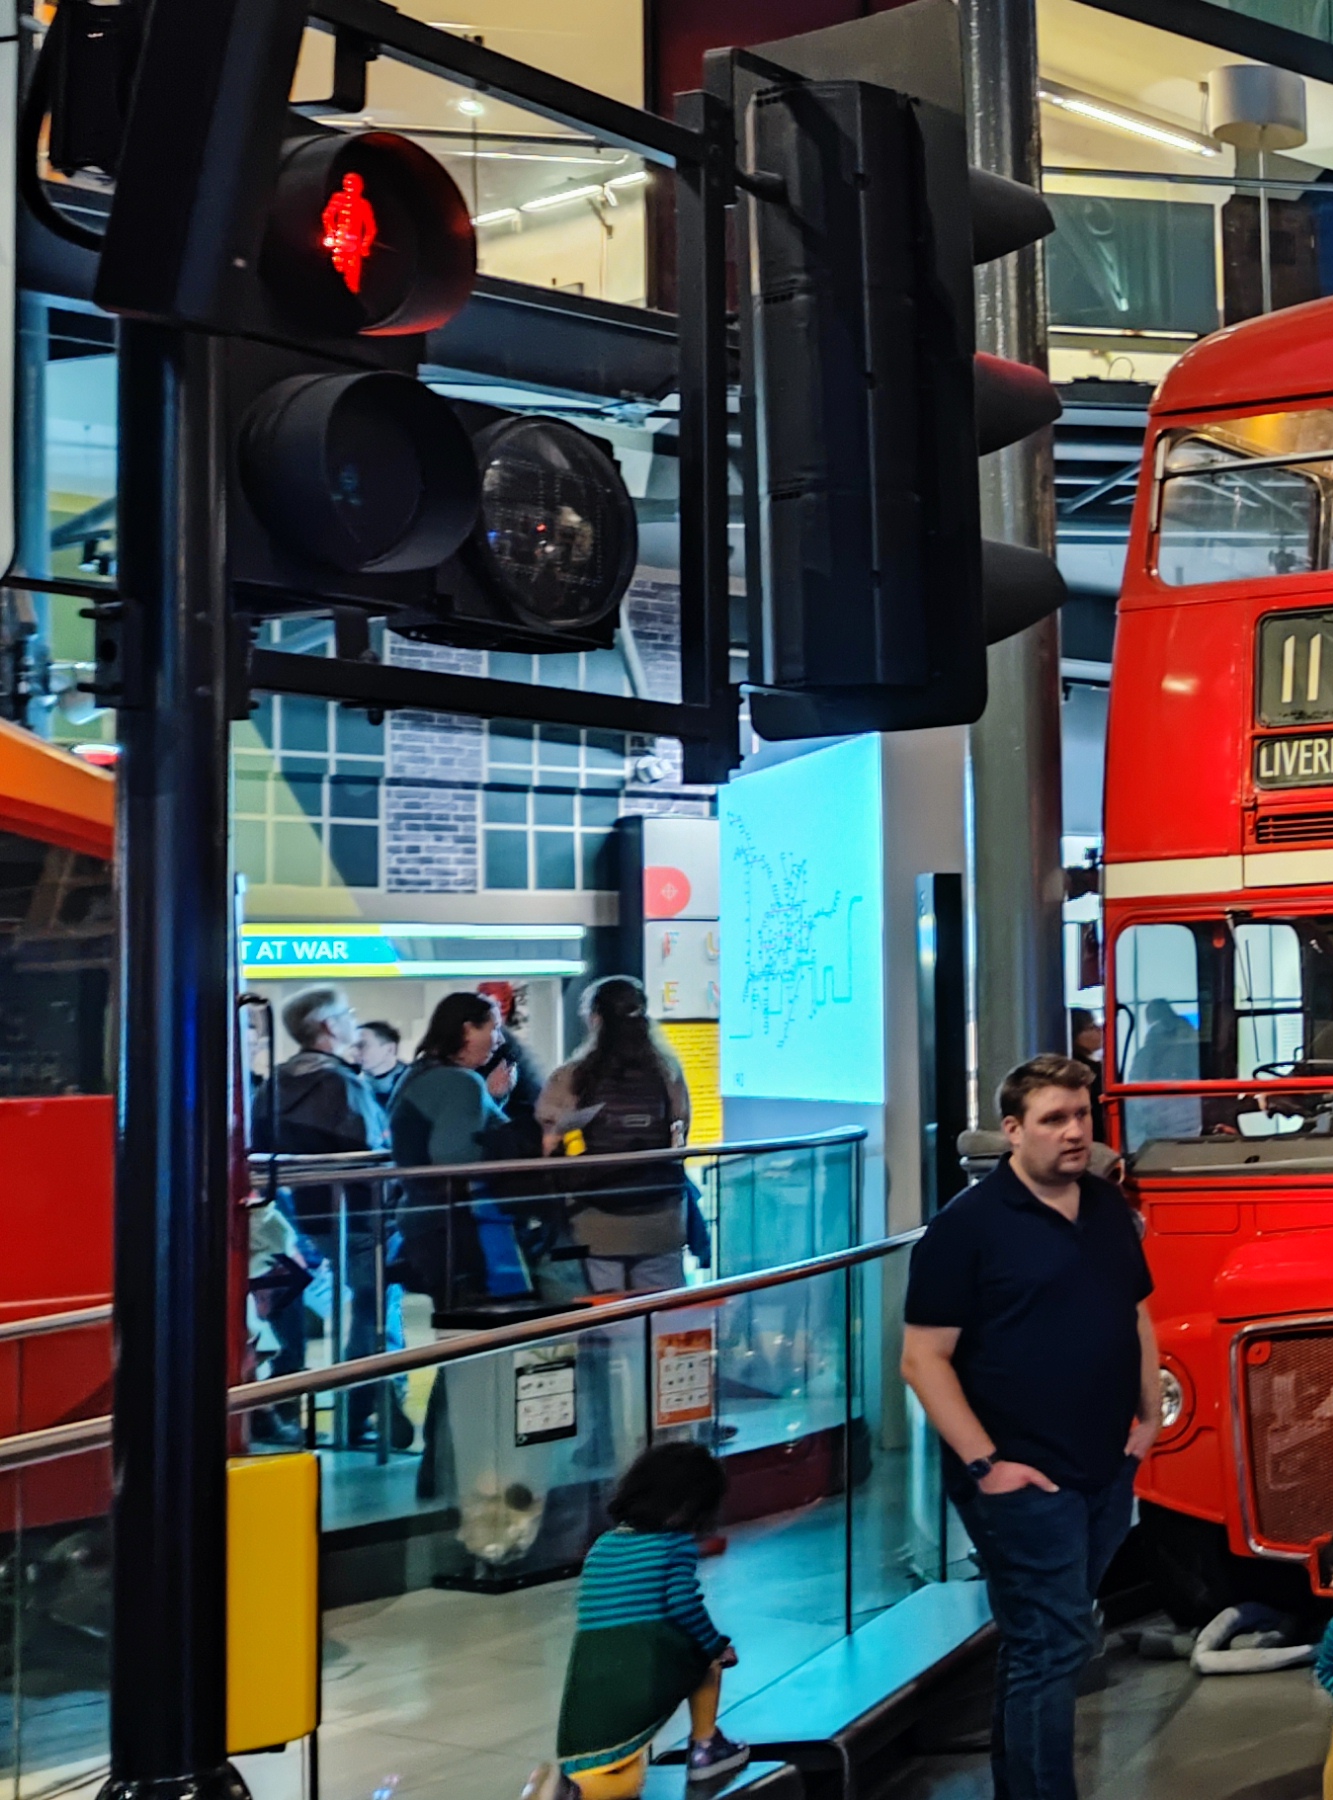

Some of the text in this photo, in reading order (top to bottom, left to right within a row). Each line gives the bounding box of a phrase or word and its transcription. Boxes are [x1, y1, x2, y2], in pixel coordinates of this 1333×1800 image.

[1281, 633, 1322, 703] 11
[256, 941, 288, 960] AT
[292, 941, 349, 960] WAR
